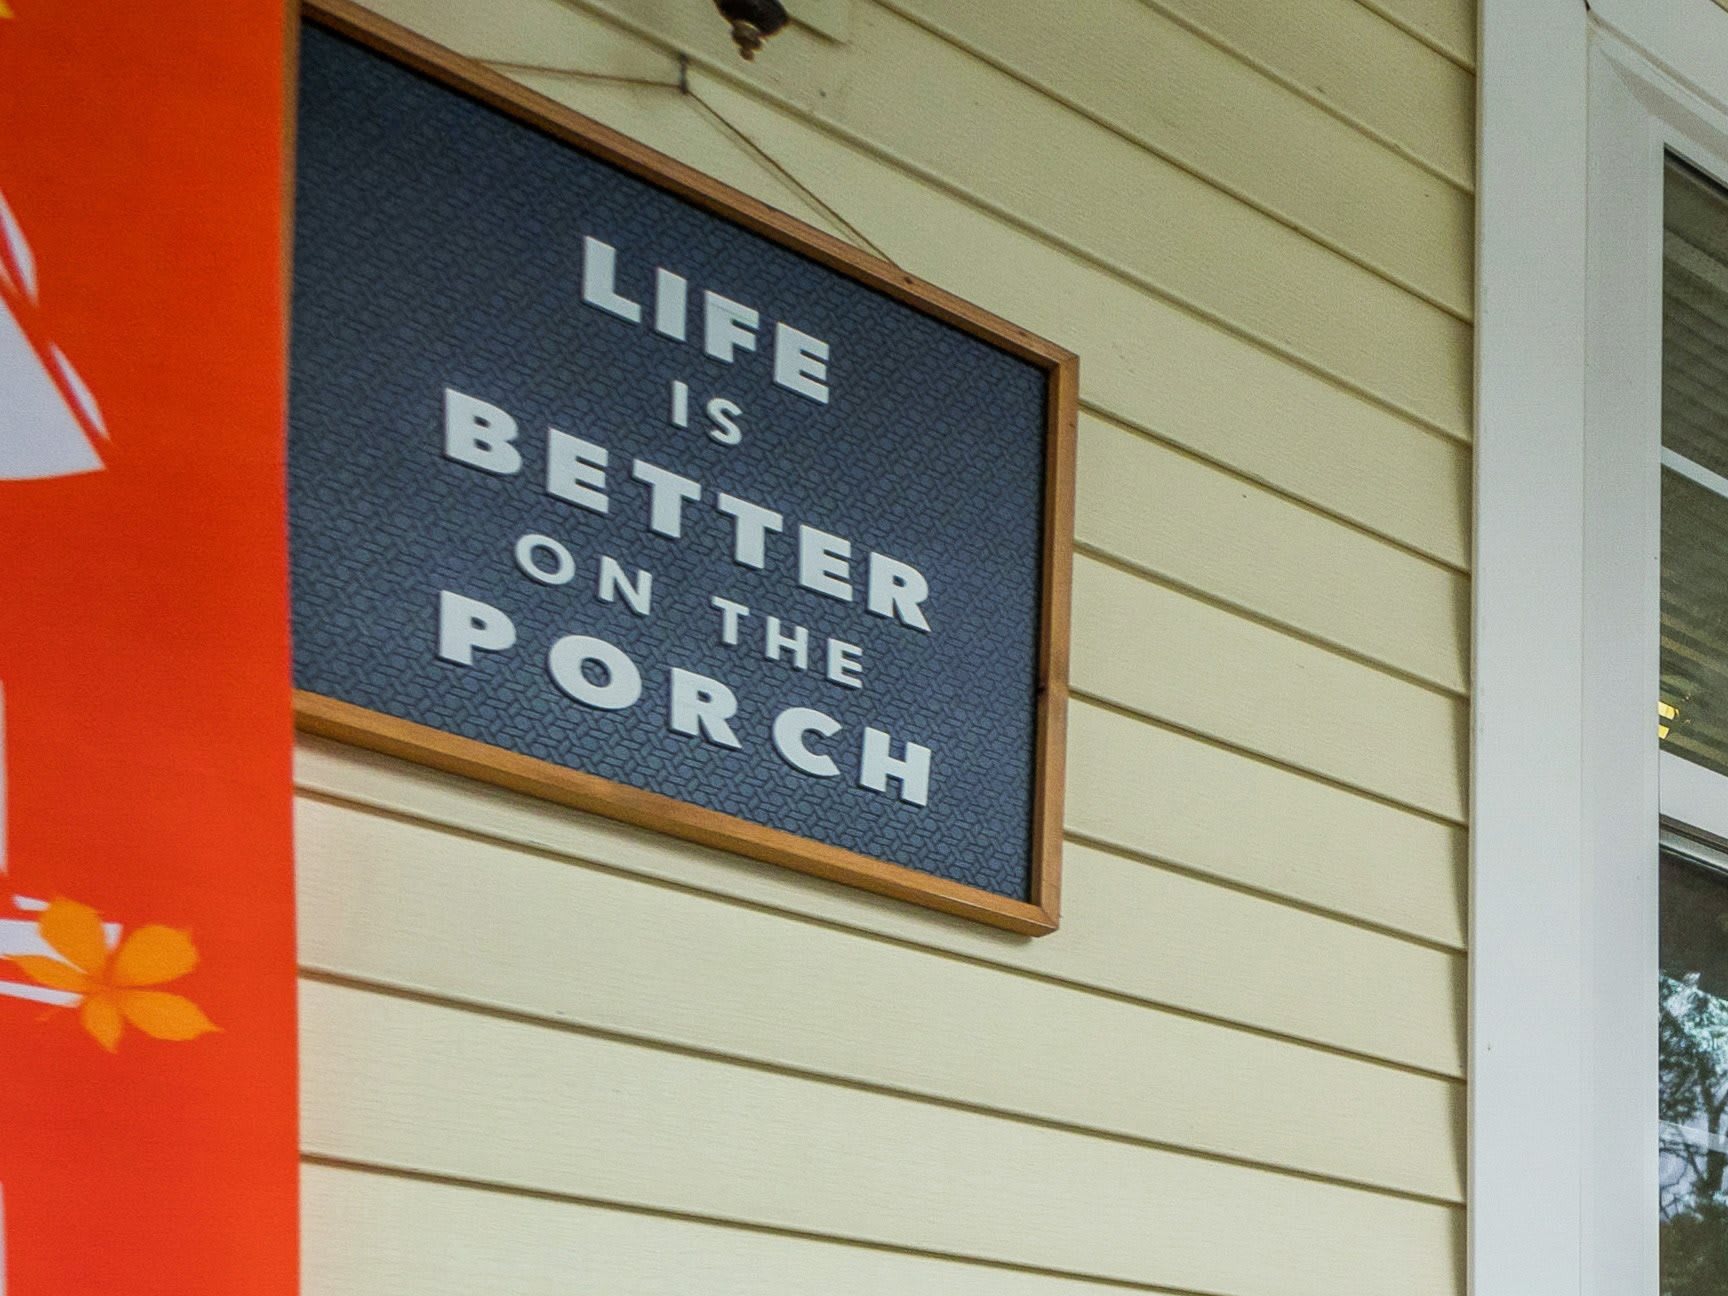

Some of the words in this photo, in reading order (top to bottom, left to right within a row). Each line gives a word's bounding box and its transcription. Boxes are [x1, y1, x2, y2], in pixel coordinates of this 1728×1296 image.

[583, 235, 830, 405] LIFE
[672, 379, 744, 446] IS
[443, 386, 933, 633] BETTER
[514, 532, 654, 617] ON
[710, 595, 864, 690] THE
[438, 588, 933, 808] PORCH
